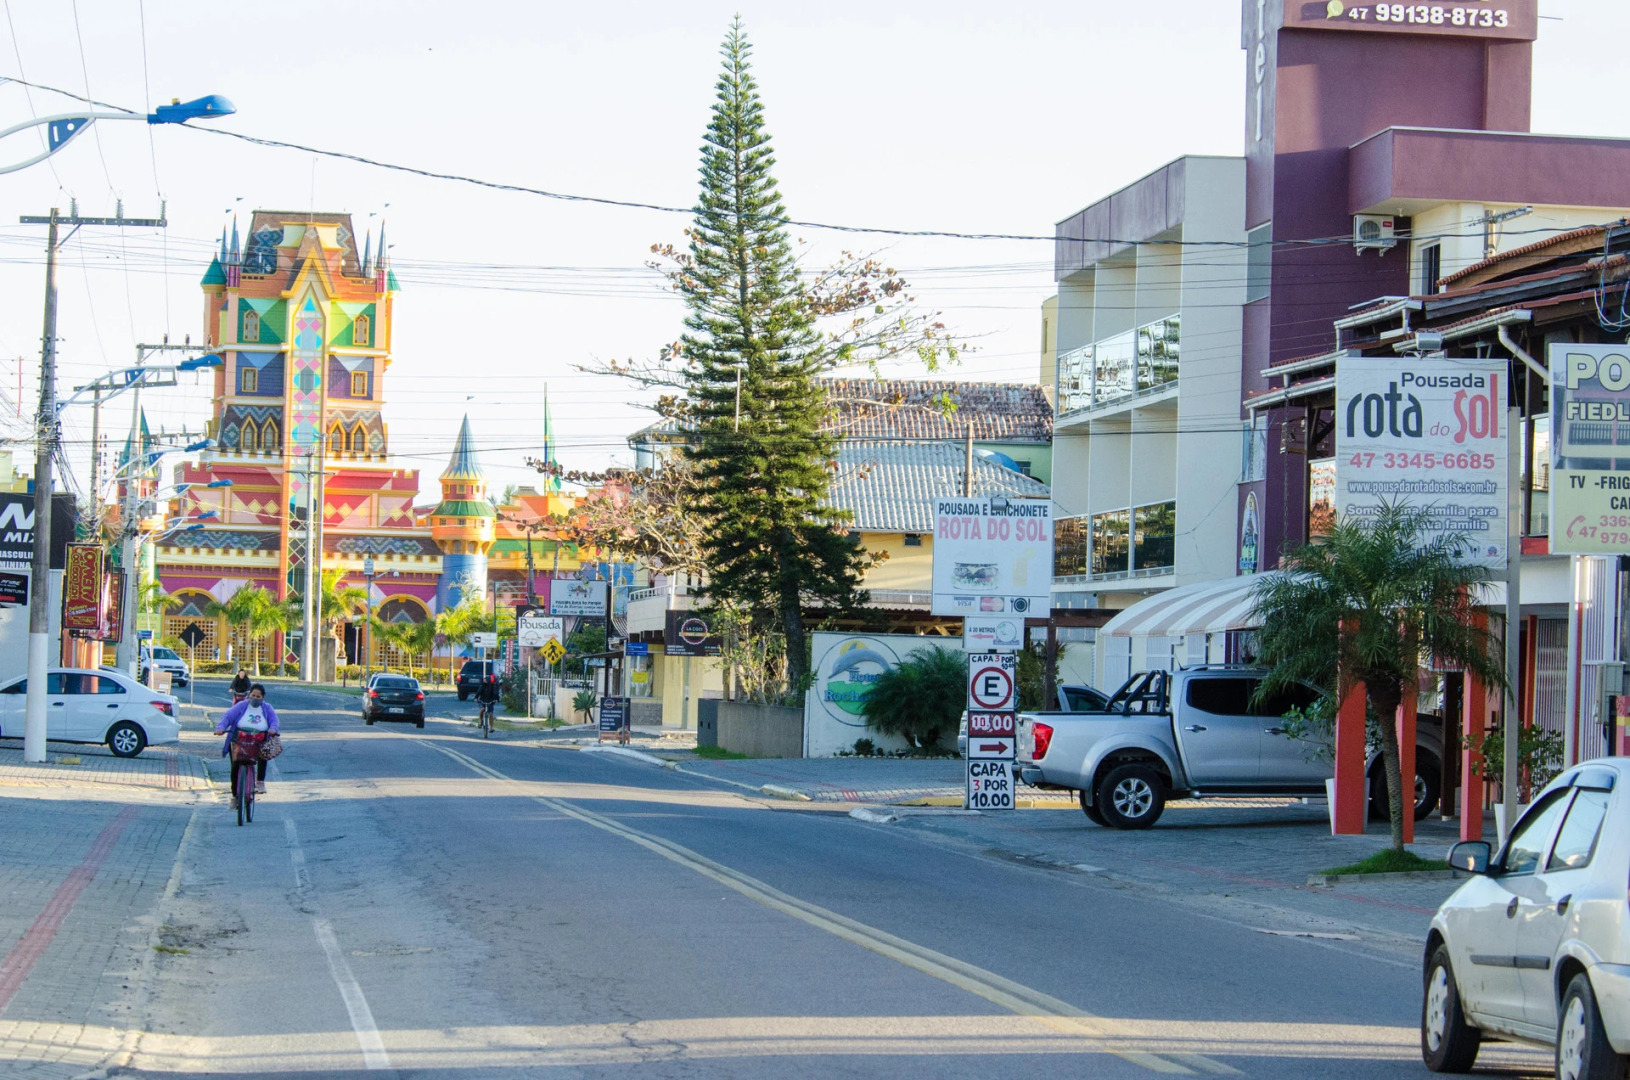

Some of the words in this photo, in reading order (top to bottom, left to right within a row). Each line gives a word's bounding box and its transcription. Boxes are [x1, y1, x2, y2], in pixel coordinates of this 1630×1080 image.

[1348, 8, 1368, 20] 47
[1375, 3, 1508, 28] 99138-8733
[1401, 372, 1485, 388] Pousada
[1346, 381, 1423, 438] rota
[1430, 421, 1450, 436] do
[1350, 453, 1375, 468] 47
[1384, 453, 1495, 469] 3345-6685
[1569, 475, 1586, 489] TV
[938, 503, 980, 516] POUSADA
[982, 504, 988, 515] E
[1611, 496, 1630, 510] CA
[1469, 506, 1498, 517] para
[1599, 515, 1630, 527] 336
[938, 516, 982, 540] ROTA
[987, 517, 1010, 541] DO
[1015, 518, 1048, 542] SOL
[1579, 526, 1598, 538] 47
[1600, 531, 1630, 544] 979
[520, 619, 561, 630] Pousada
[971, 655, 994, 663] CAPA
[1001, 656, 1014, 664] POR
[984, 676, 1000, 697] E
[970, 763, 1006, 777] CAPA
[973, 779, 980, 791] 3
[984, 779, 1008, 791] POR
[971, 792, 1010, 807] 10,00
